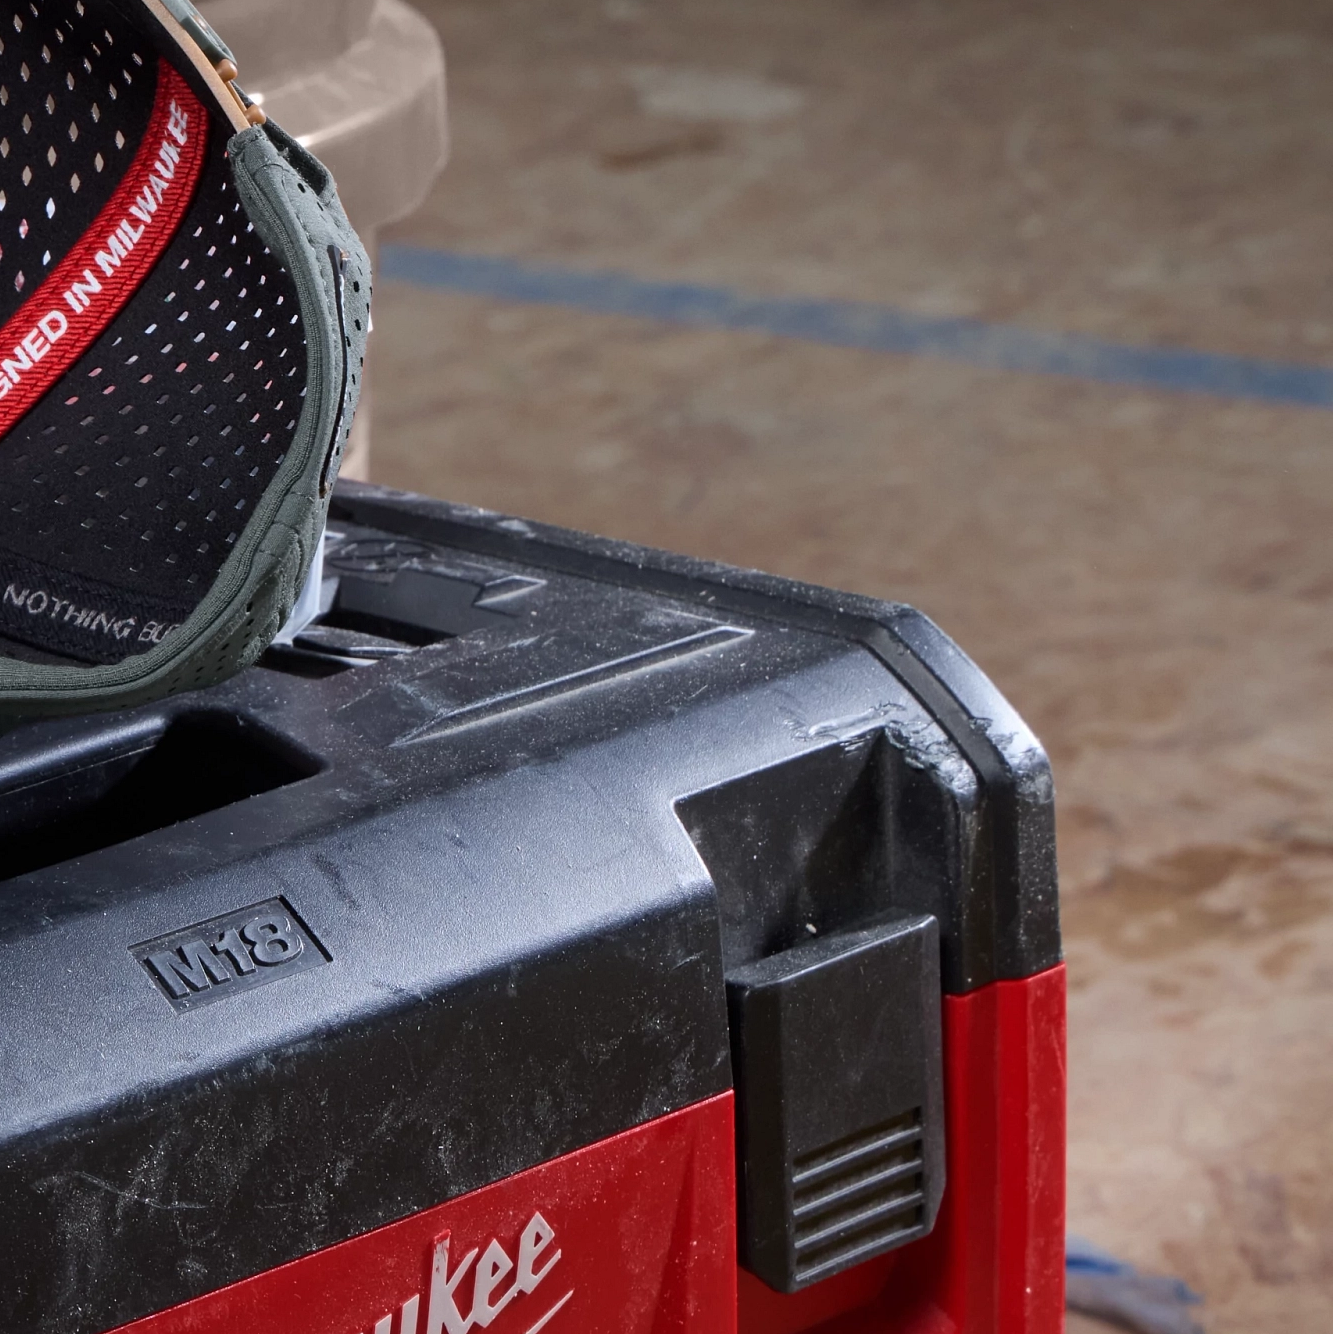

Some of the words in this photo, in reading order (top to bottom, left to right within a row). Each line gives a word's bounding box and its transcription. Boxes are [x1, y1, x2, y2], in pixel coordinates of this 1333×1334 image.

[62, 274, 102, 315] IN
[95, 97, 189, 288] MILWAUKEE
[2, 585, 137, 640] NOTHING
[145, 912, 304, 1005] M18
